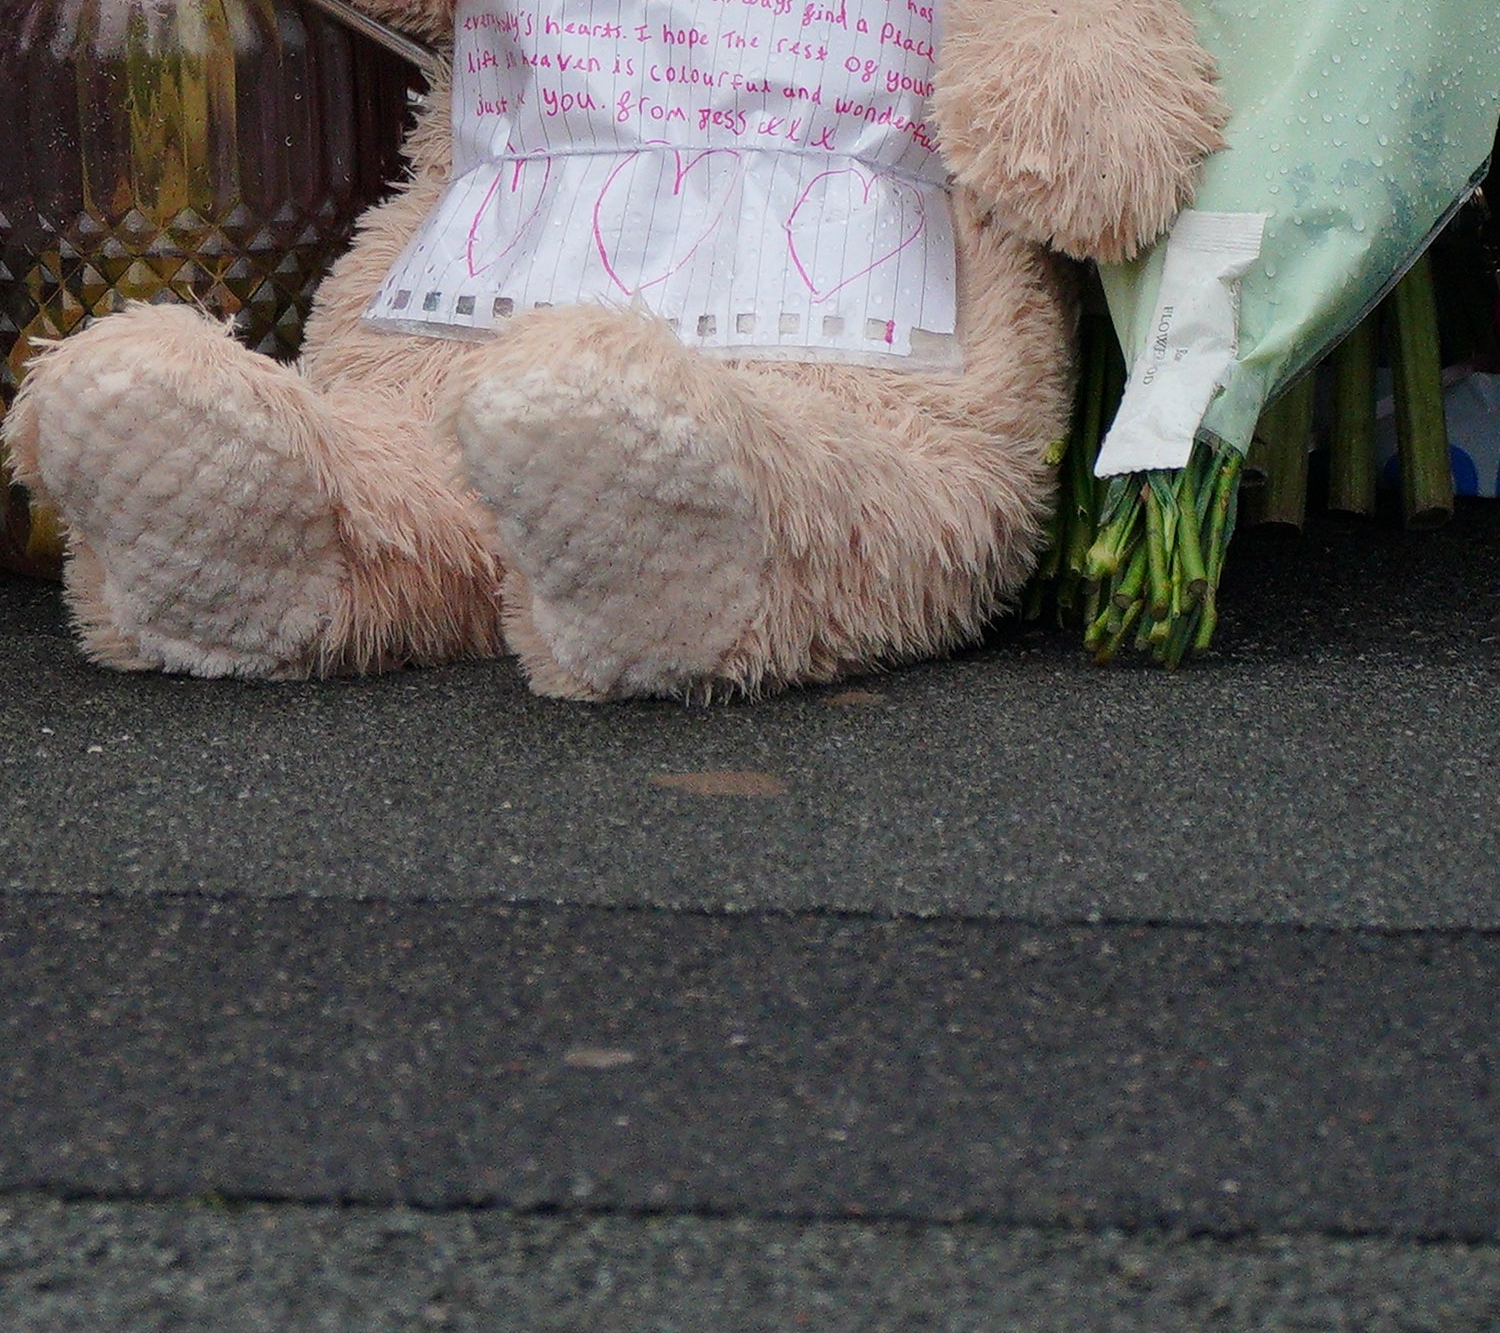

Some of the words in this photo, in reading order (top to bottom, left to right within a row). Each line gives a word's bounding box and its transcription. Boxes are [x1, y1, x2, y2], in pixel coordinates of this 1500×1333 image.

[856, 18, 869, 34] a
[467, 48, 499, 73] life
[521, 49, 602, 72] heaven
[612, 53, 635, 77] is
[650, 64, 772, 93] colourful
[782, 85, 822, 106] and
[634, 23, 652, 43] I
[662, 23, 710, 49] hope
[777, 38, 828, 62] rest
[885, 69, 936, 98] your
[476, 92, 509, 117] just
[616, 89, 688, 122] from
